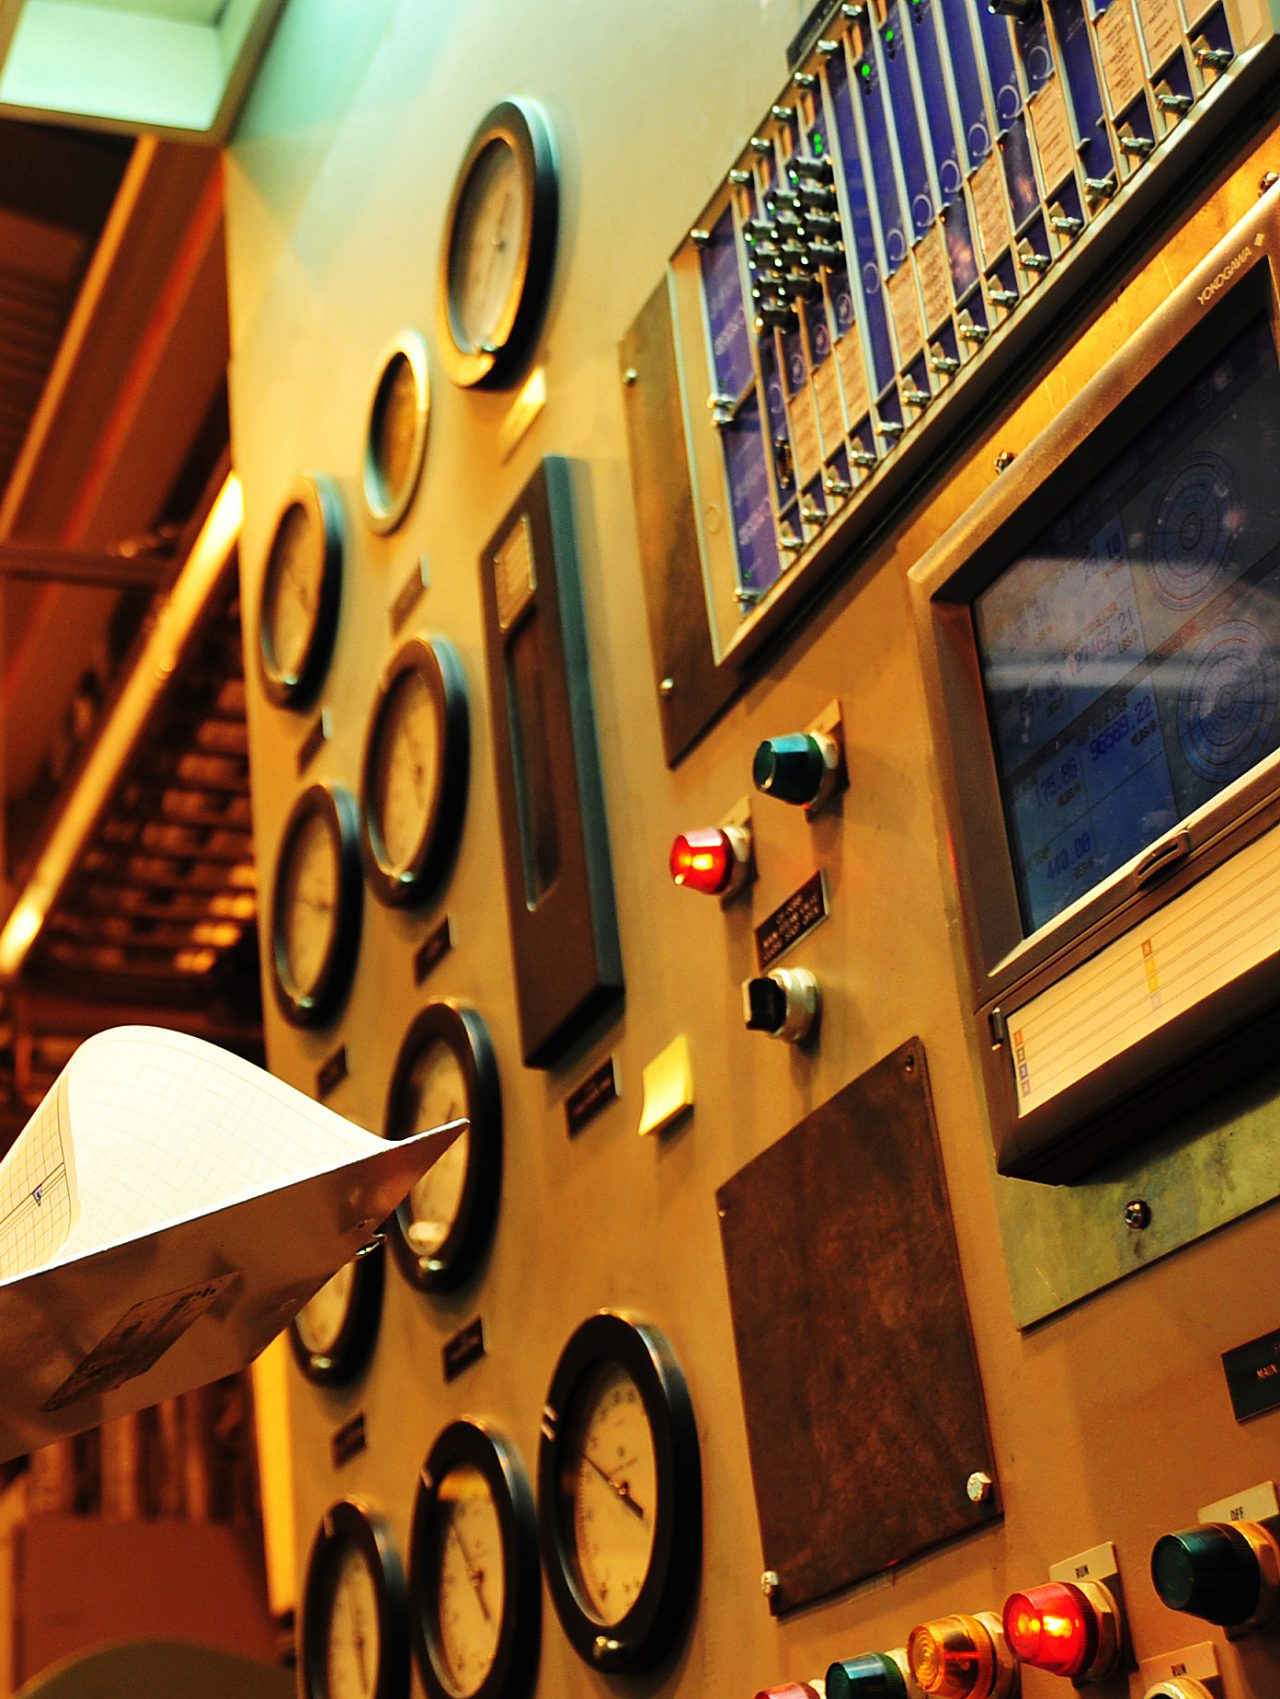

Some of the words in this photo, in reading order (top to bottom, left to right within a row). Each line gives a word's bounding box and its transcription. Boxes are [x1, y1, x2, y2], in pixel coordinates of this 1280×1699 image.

[1197, 246, 1252, 305] YOKOGAWA
[1229, 1506, 1245, 1522] OFF
[1075, 1564, 1090, 1580] RUN
[1170, 1663, 1187, 1677] RUN
